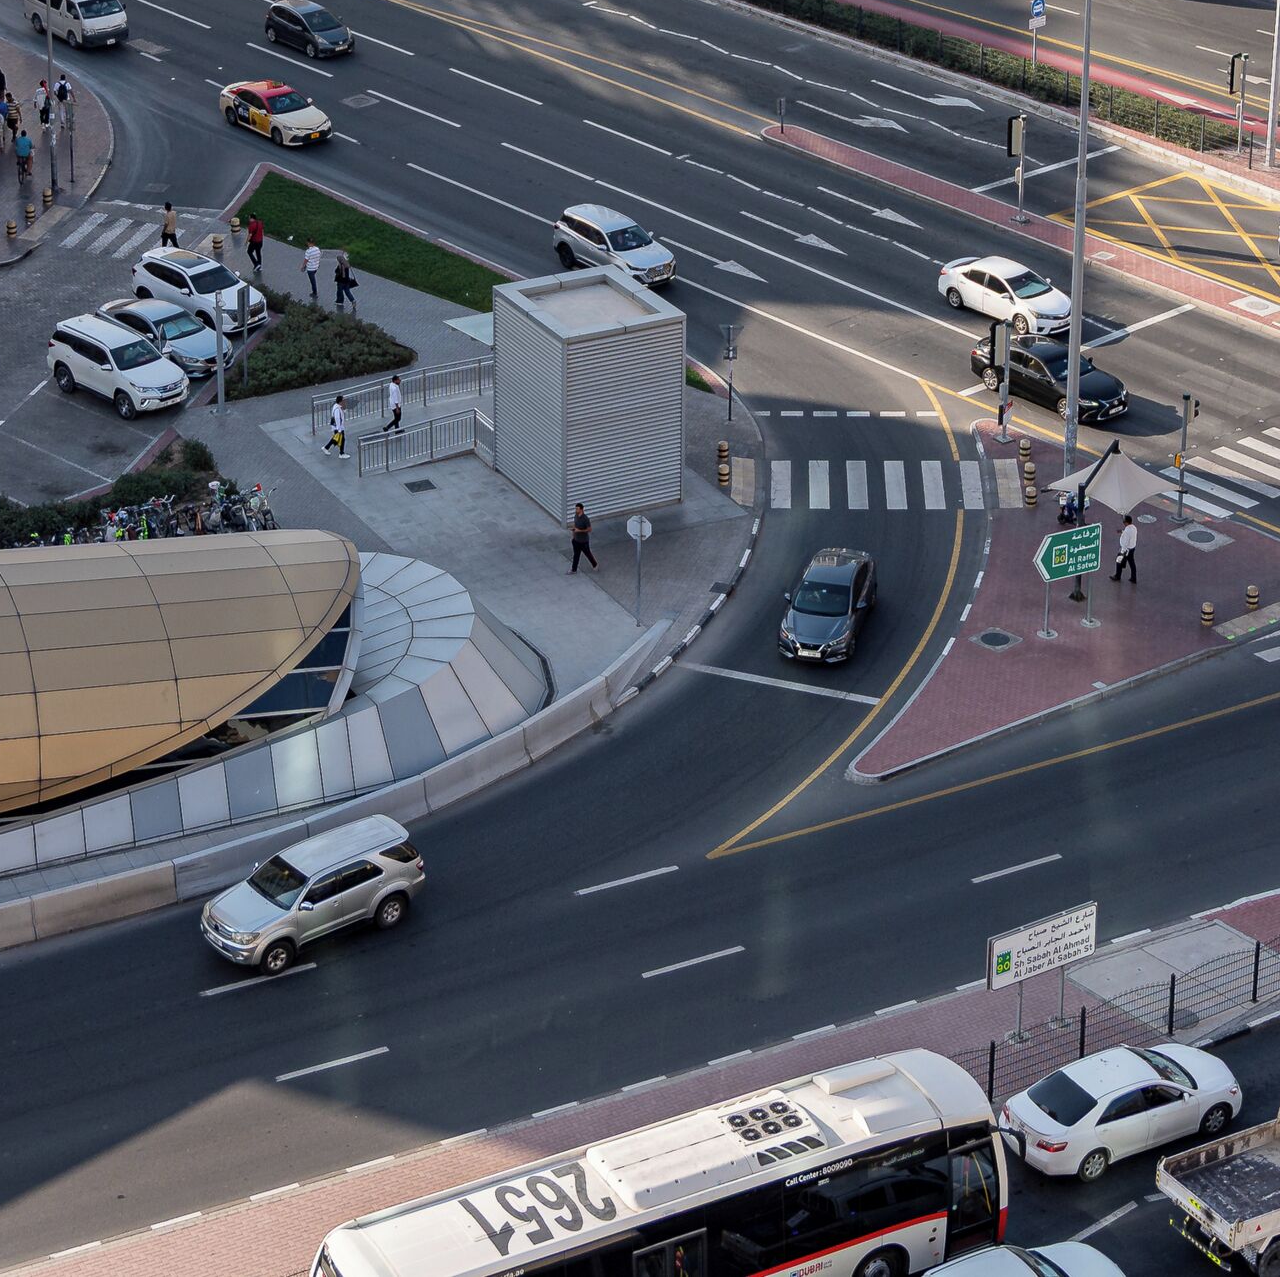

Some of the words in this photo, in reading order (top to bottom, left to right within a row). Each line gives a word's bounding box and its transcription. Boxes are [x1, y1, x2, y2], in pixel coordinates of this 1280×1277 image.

[1072, 527, 1100, 540] الرفاعة
[1069, 539, 1099, 553] السطوة
[1068, 557, 1076, 565] Al
[1077, 553, 1096, 563] Raffa
[1076, 561, 1098, 570] Satwa
[1076, 909, 1095, 924] شارع
[1051, 916, 1073, 933] الشيخ
[1068, 923, 1091, 937] الأحمد
[1028, 928, 1047, 941] صباح
[1044, 932, 1065, 948] الجابر
[1014, 960, 1025, 970] Sh
[1026, 950, 1051, 965] Sabah
[1053, 945, 1061, 955] Al
[1063, 935, 1090, 951] Ahmad
[1016, 940, 1042, 959] الصباح
[996, 961, 1011, 974] 90
[1013, 970, 1022, 979] Al
[1024, 962, 1045, 976] Jaber
[1046, 958, 1055, 967] Al
[1057, 948, 1082, 962] Sabah
[1083, 943, 1093, 953] St
[785, 1176, 798, 1187] Call
[822, 1158, 853, 1174] 8009090
[798, 1261, 824, 1277] DUBAI
